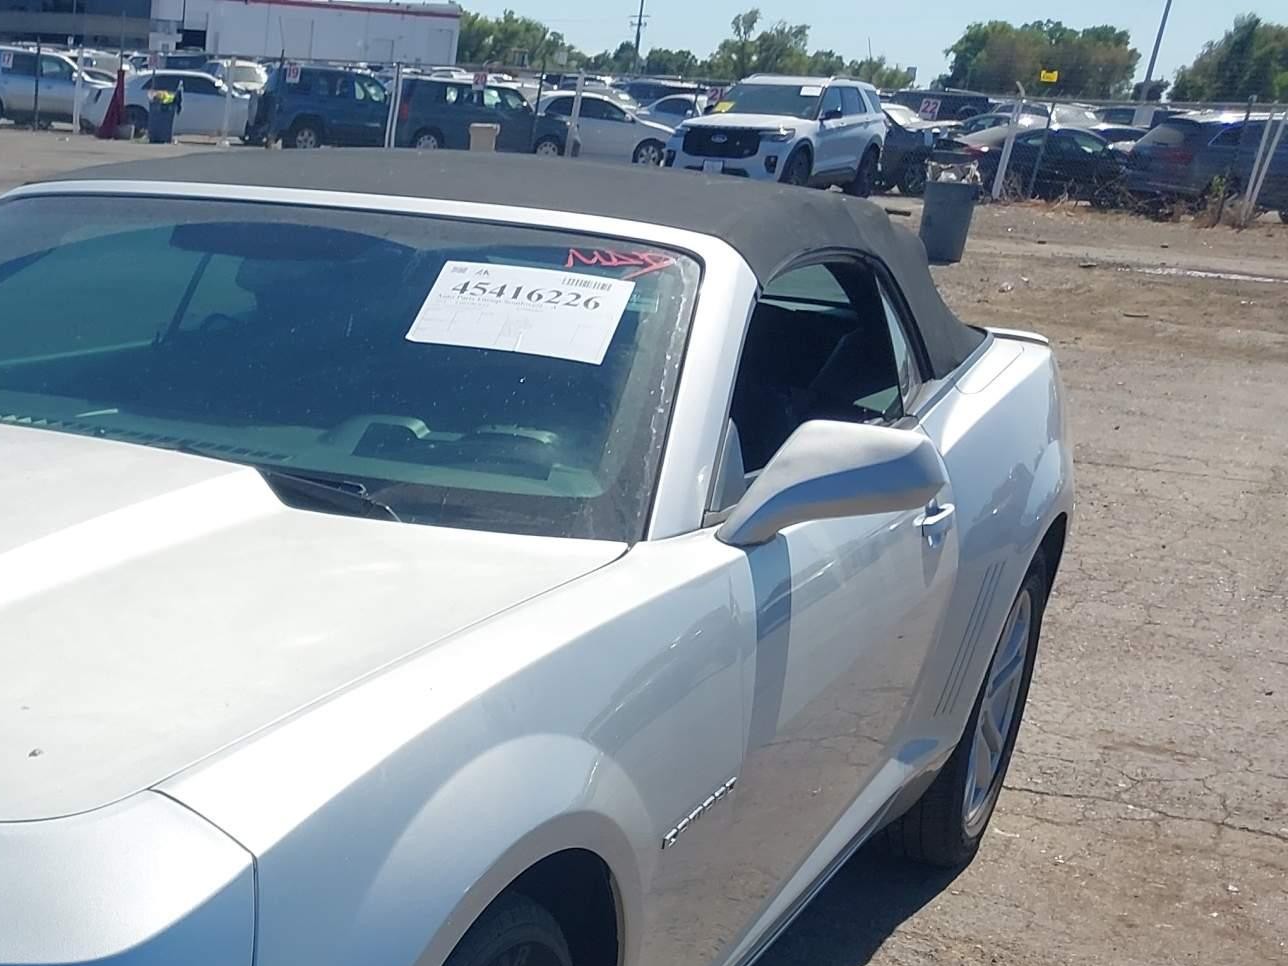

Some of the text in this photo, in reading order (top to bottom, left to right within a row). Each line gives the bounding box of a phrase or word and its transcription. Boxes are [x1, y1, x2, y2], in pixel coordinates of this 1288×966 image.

[473, 72, 487, 87] 20
[921, 100, 939, 113] 22
[451, 280, 602, 311] 45416226
